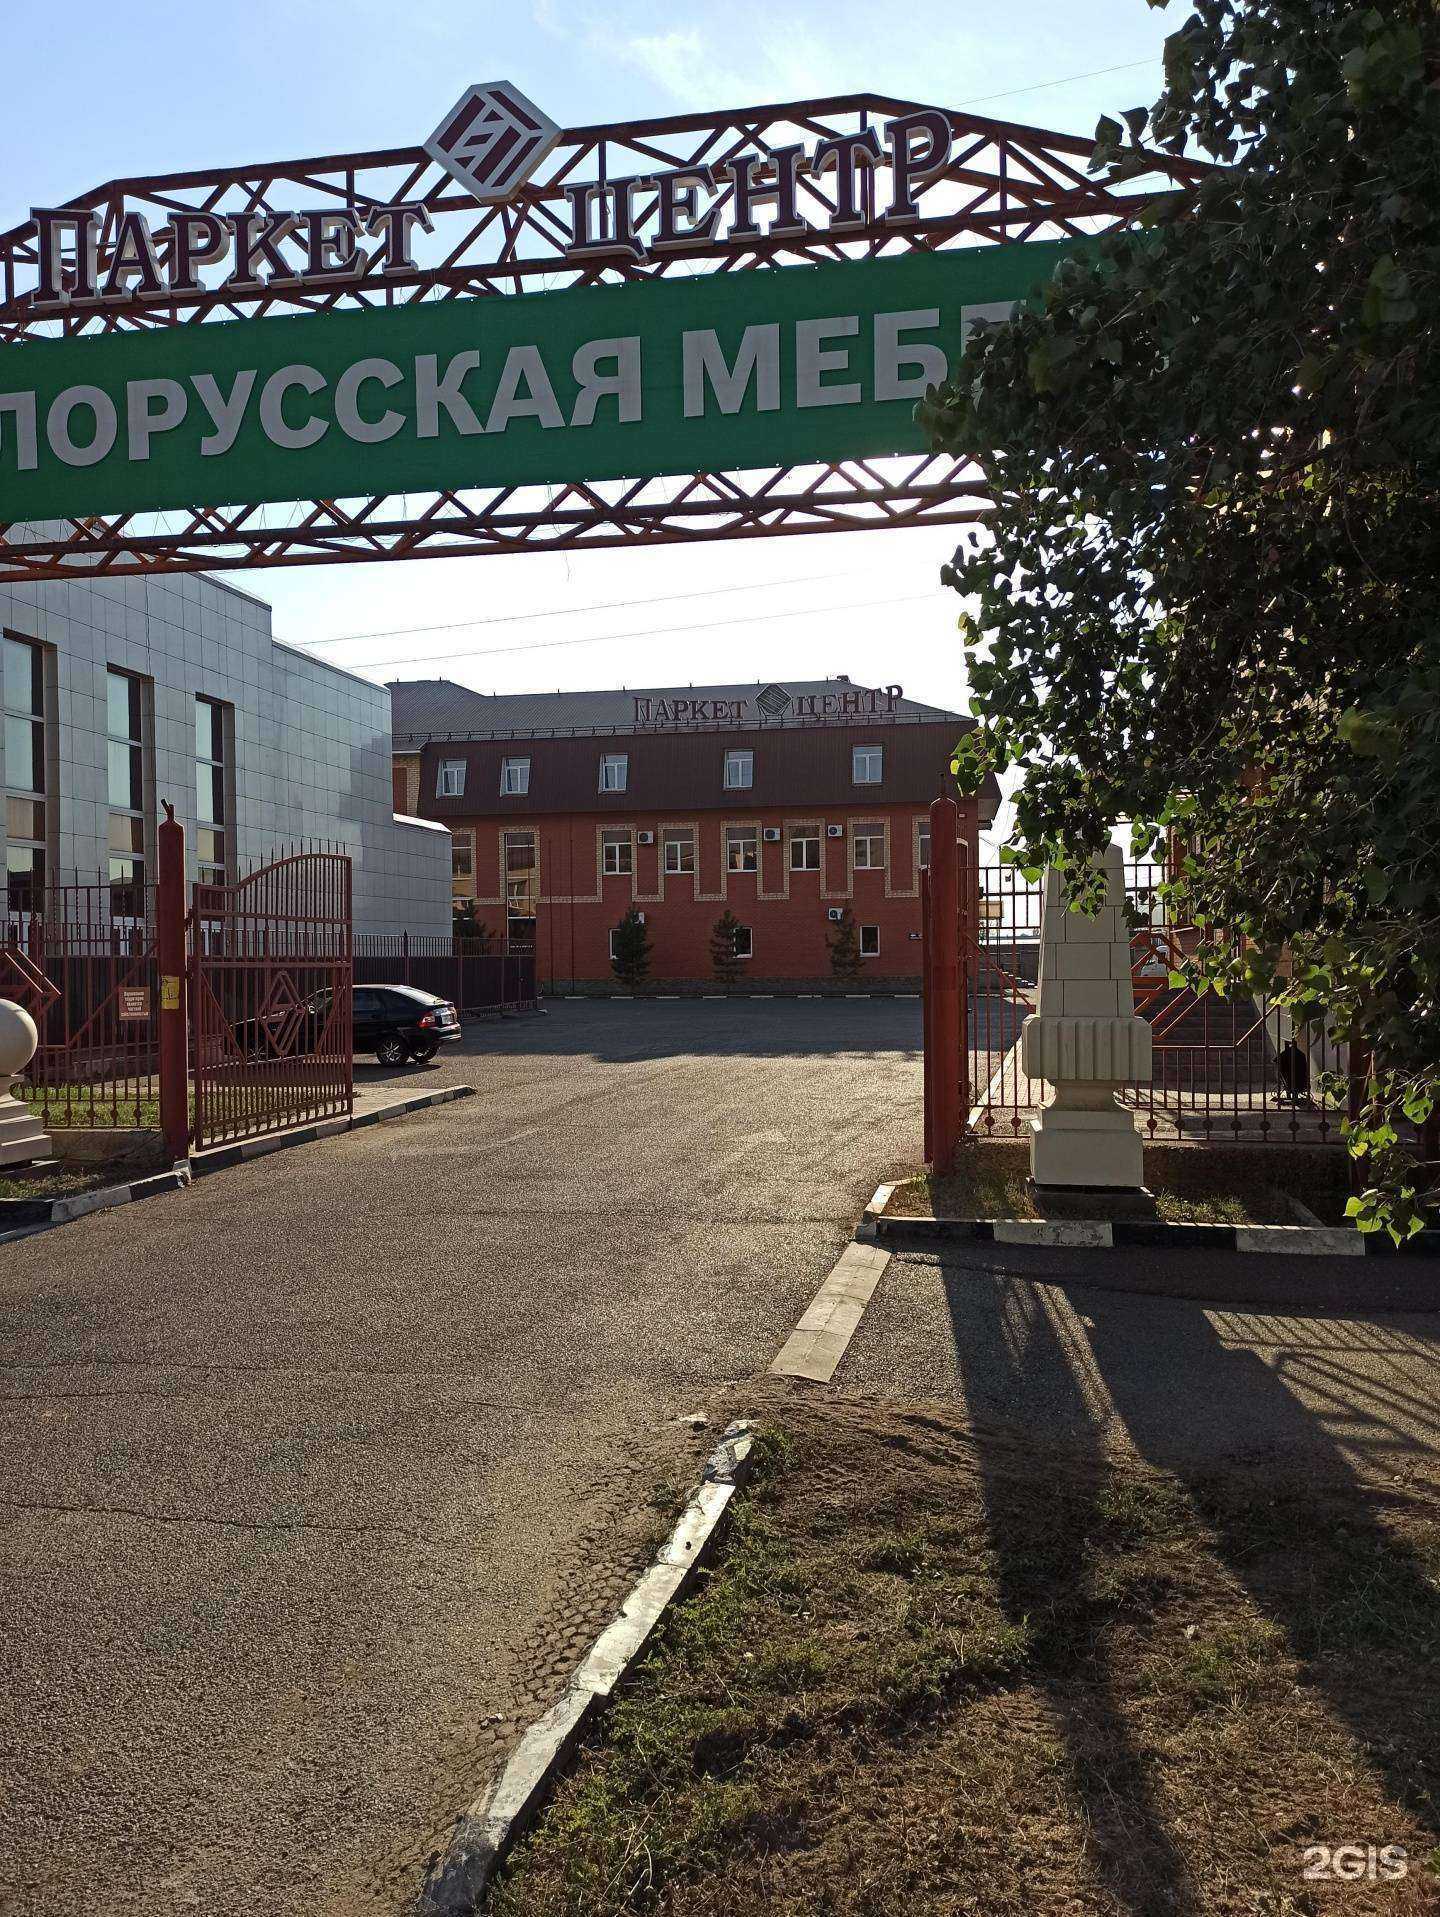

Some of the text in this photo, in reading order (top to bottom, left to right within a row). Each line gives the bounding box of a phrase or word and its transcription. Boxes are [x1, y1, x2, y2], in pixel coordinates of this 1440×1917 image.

[30, 109, 953, 308] ПАРКЕТ ЦЕНТР
[633, 684, 904, 722] ПАРКЕТ ЦЕНТР
